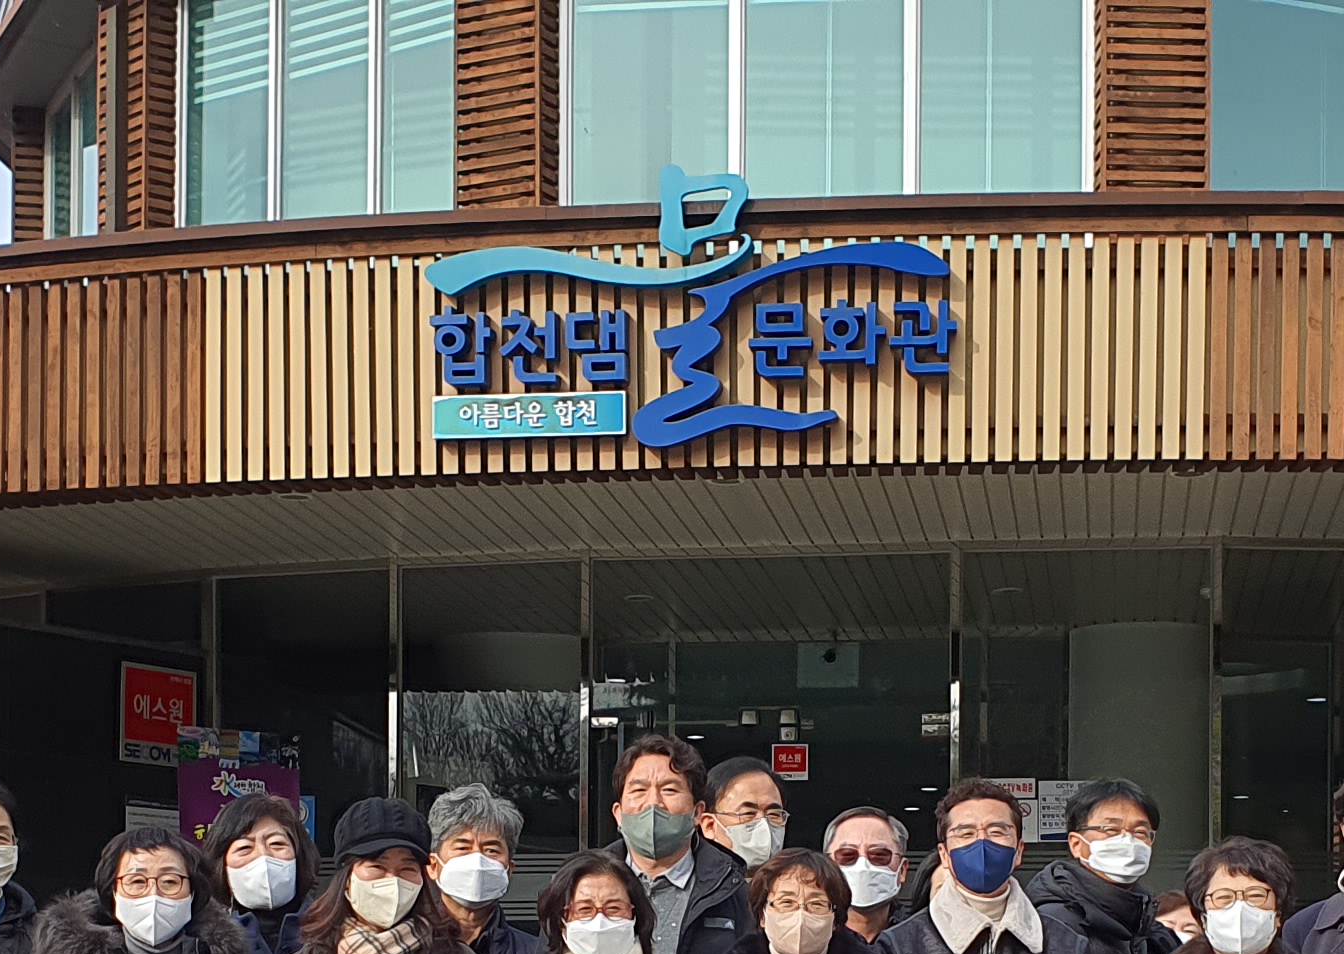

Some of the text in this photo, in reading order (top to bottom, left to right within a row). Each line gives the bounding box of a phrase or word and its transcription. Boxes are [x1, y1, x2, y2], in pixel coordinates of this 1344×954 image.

[429, 306, 629, 387] 합천댐
[748, 299, 957, 379] 문화관
[458, 401, 598, 428] 아름다운 합천
[133, 693, 184, 724] 에스원
[124, 742, 171, 763] SEOM
